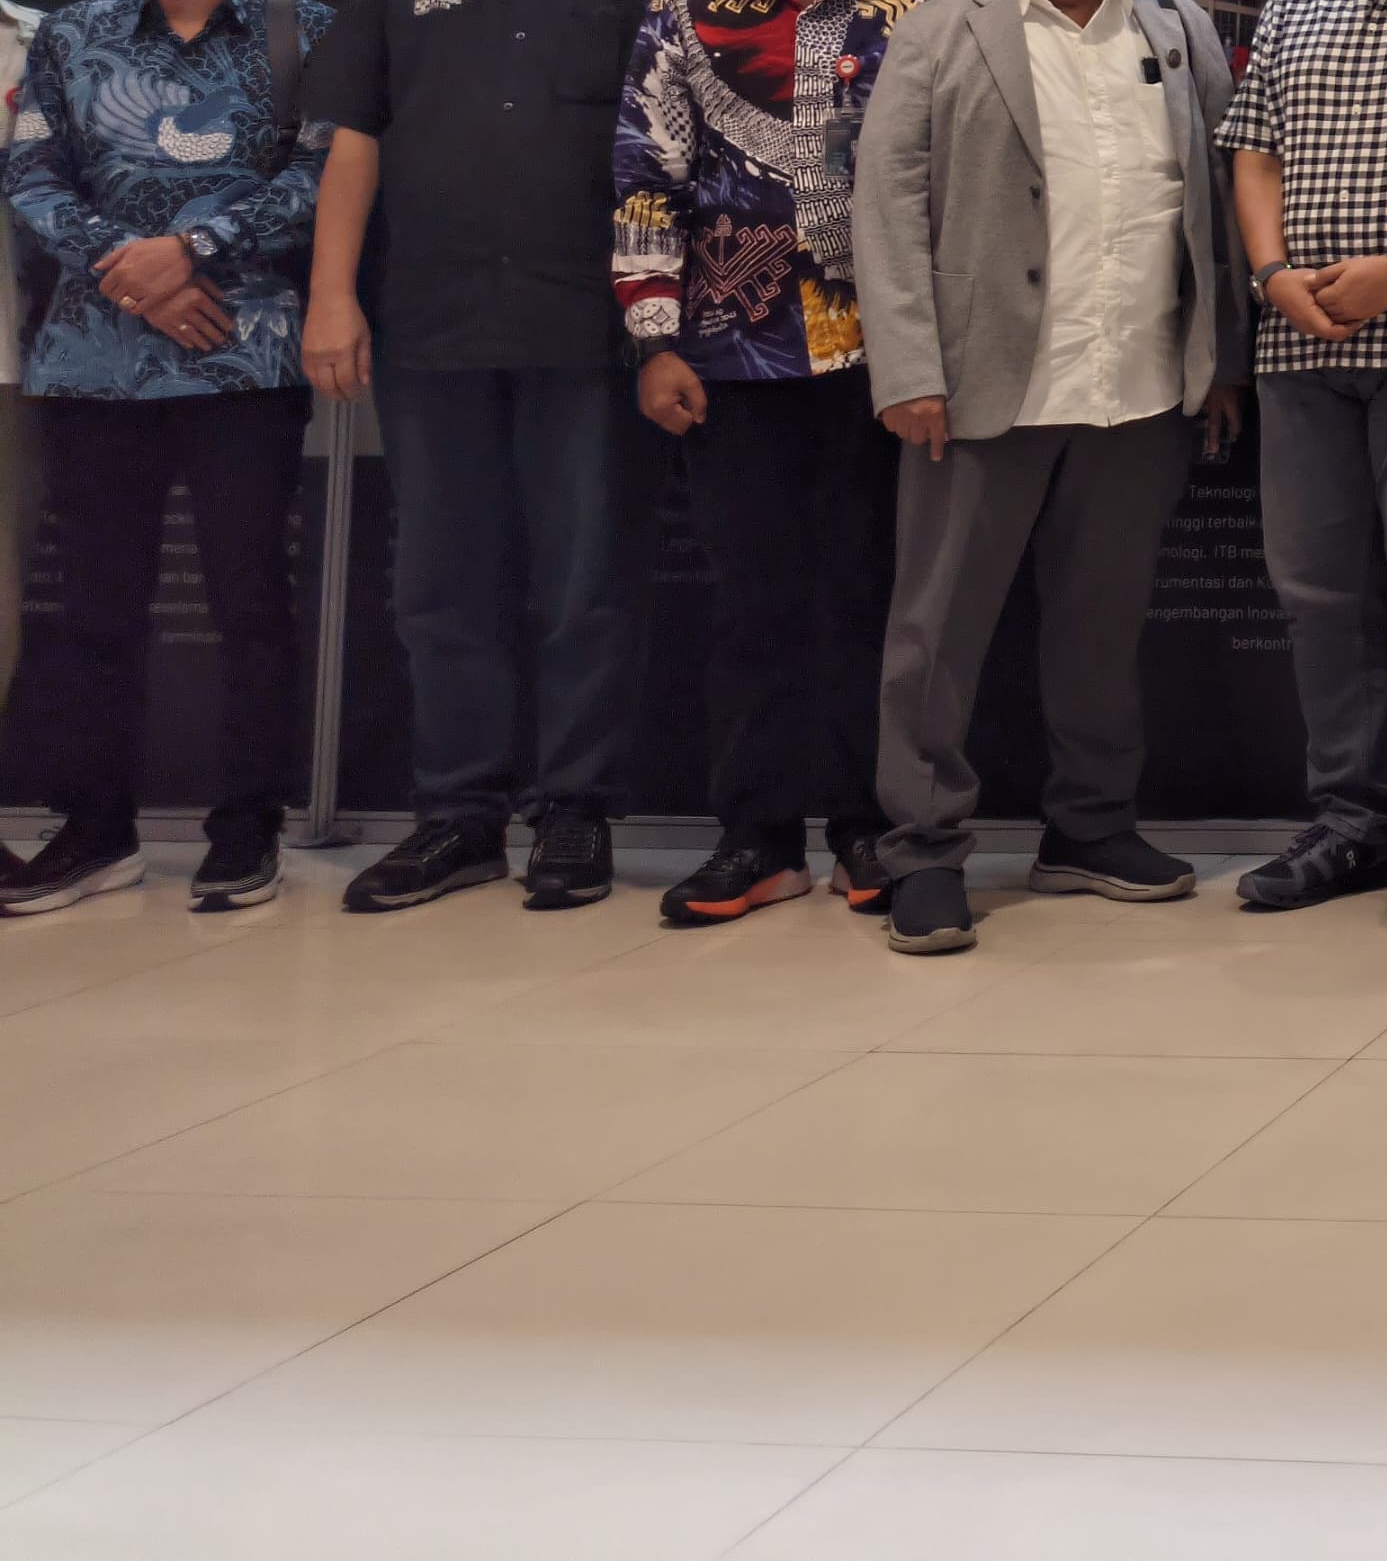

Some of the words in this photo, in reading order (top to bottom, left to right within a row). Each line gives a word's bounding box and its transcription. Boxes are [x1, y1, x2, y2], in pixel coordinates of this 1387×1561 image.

[1214, 544, 1237, 559] ITB
[1229, 575, 1253, 589] dan
[1148, 606, 1244, 622] engembangan
[1232, 635, 1293, 650] berkontr
